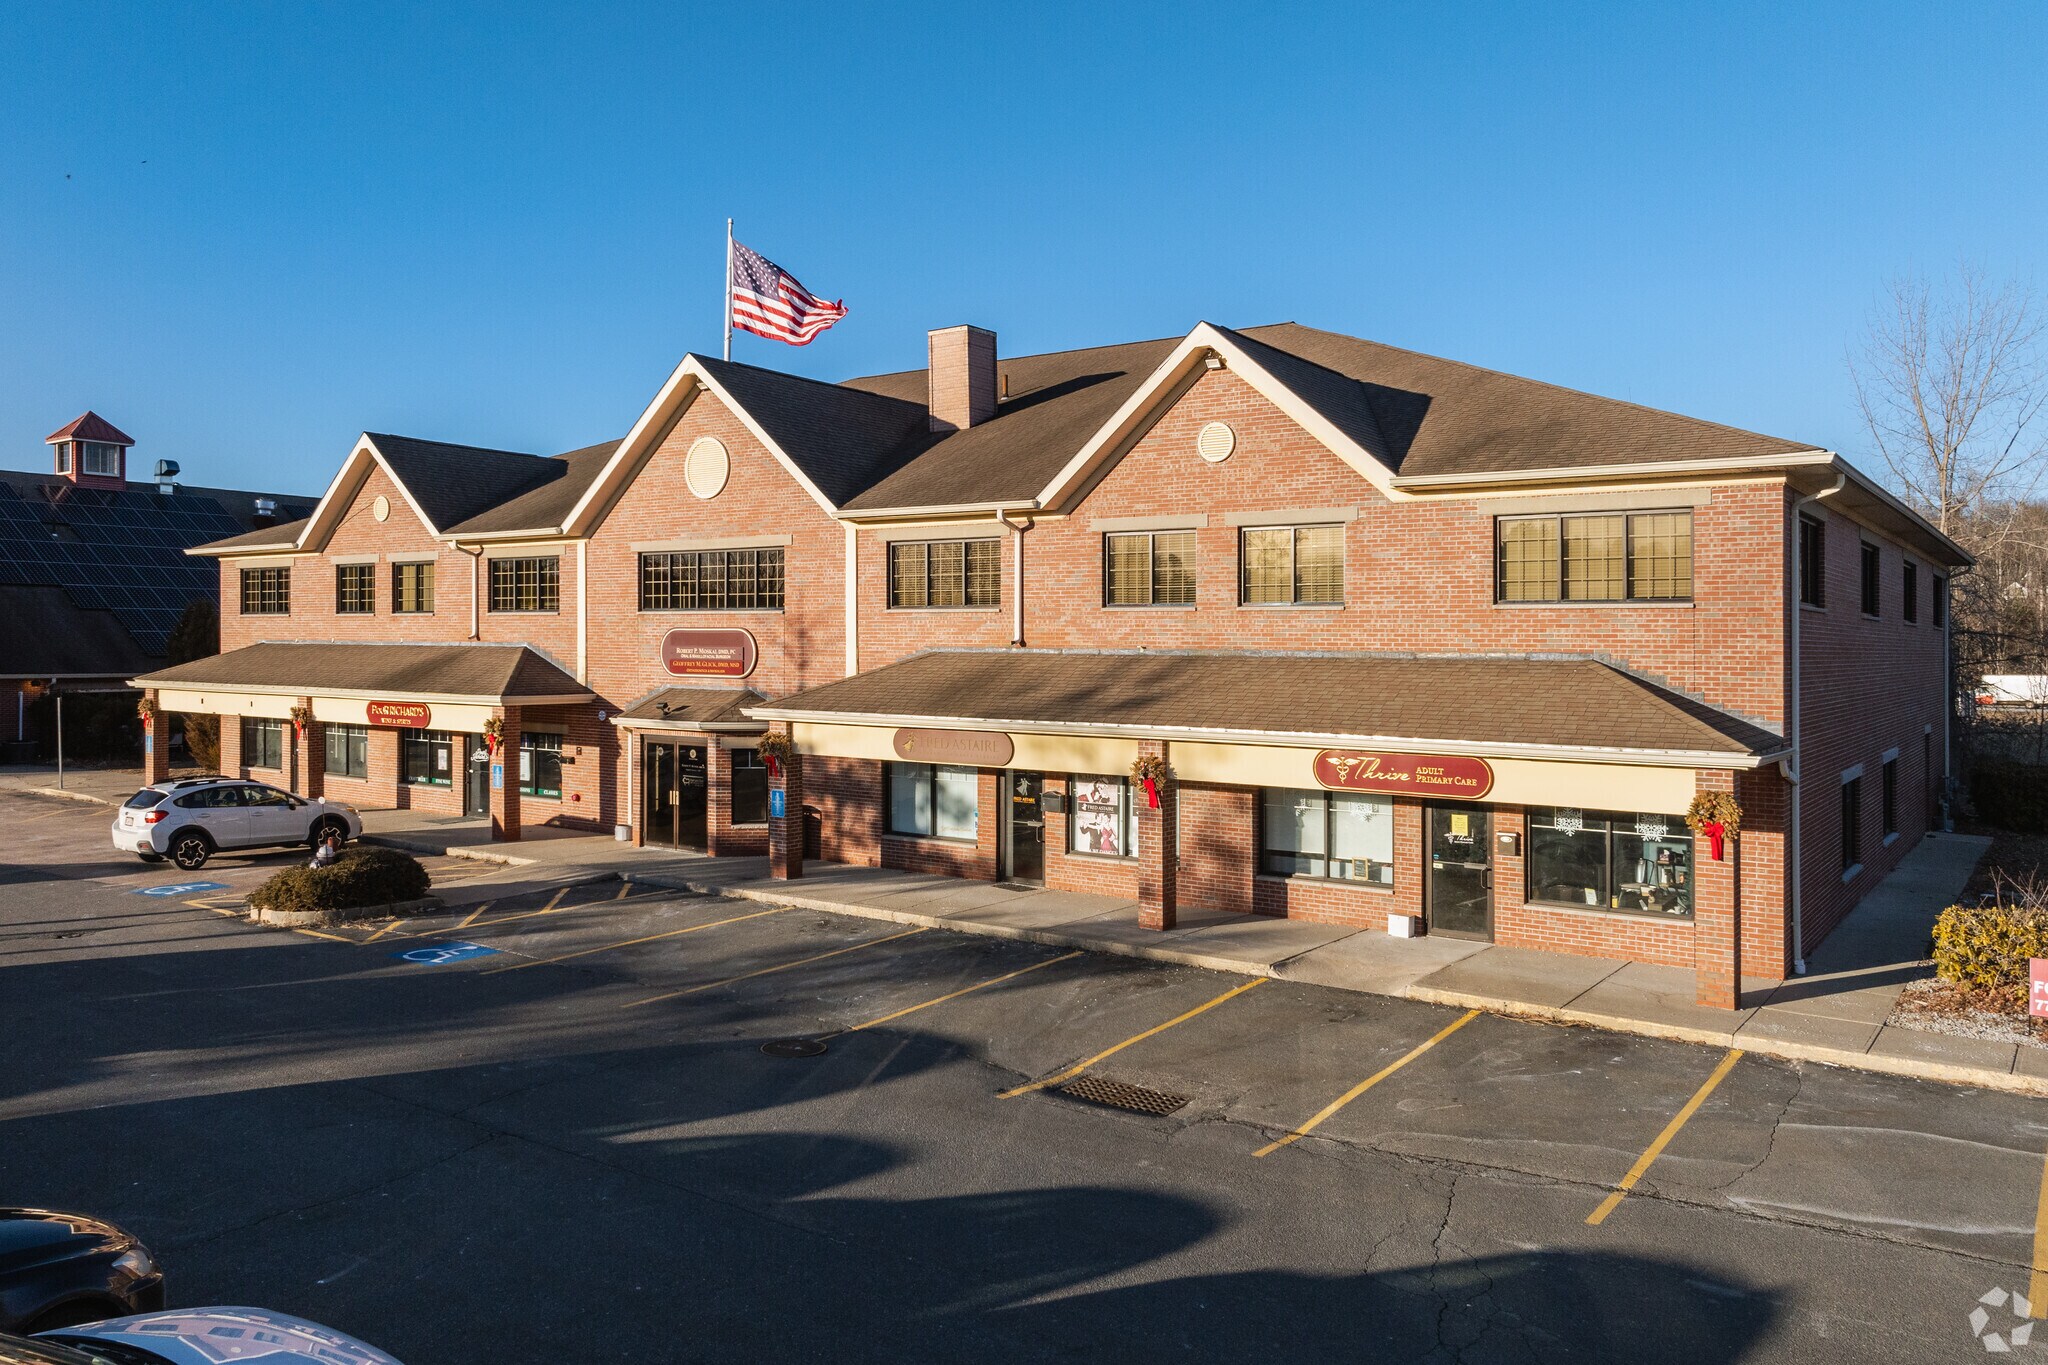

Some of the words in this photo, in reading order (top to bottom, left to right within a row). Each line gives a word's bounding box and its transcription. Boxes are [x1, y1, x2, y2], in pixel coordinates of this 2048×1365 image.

[389, 706, 424, 717] RICHARD'S
[920, 736, 949, 749] FRED
[952, 739, 1000, 753] ASTAIRE
[1354, 756, 1411, 781] Thrive
[1415, 766, 1444, 775] ADULT
[1415, 774, 1453, 785] PRIMARY
[1454, 776, 1478, 787] CARE
